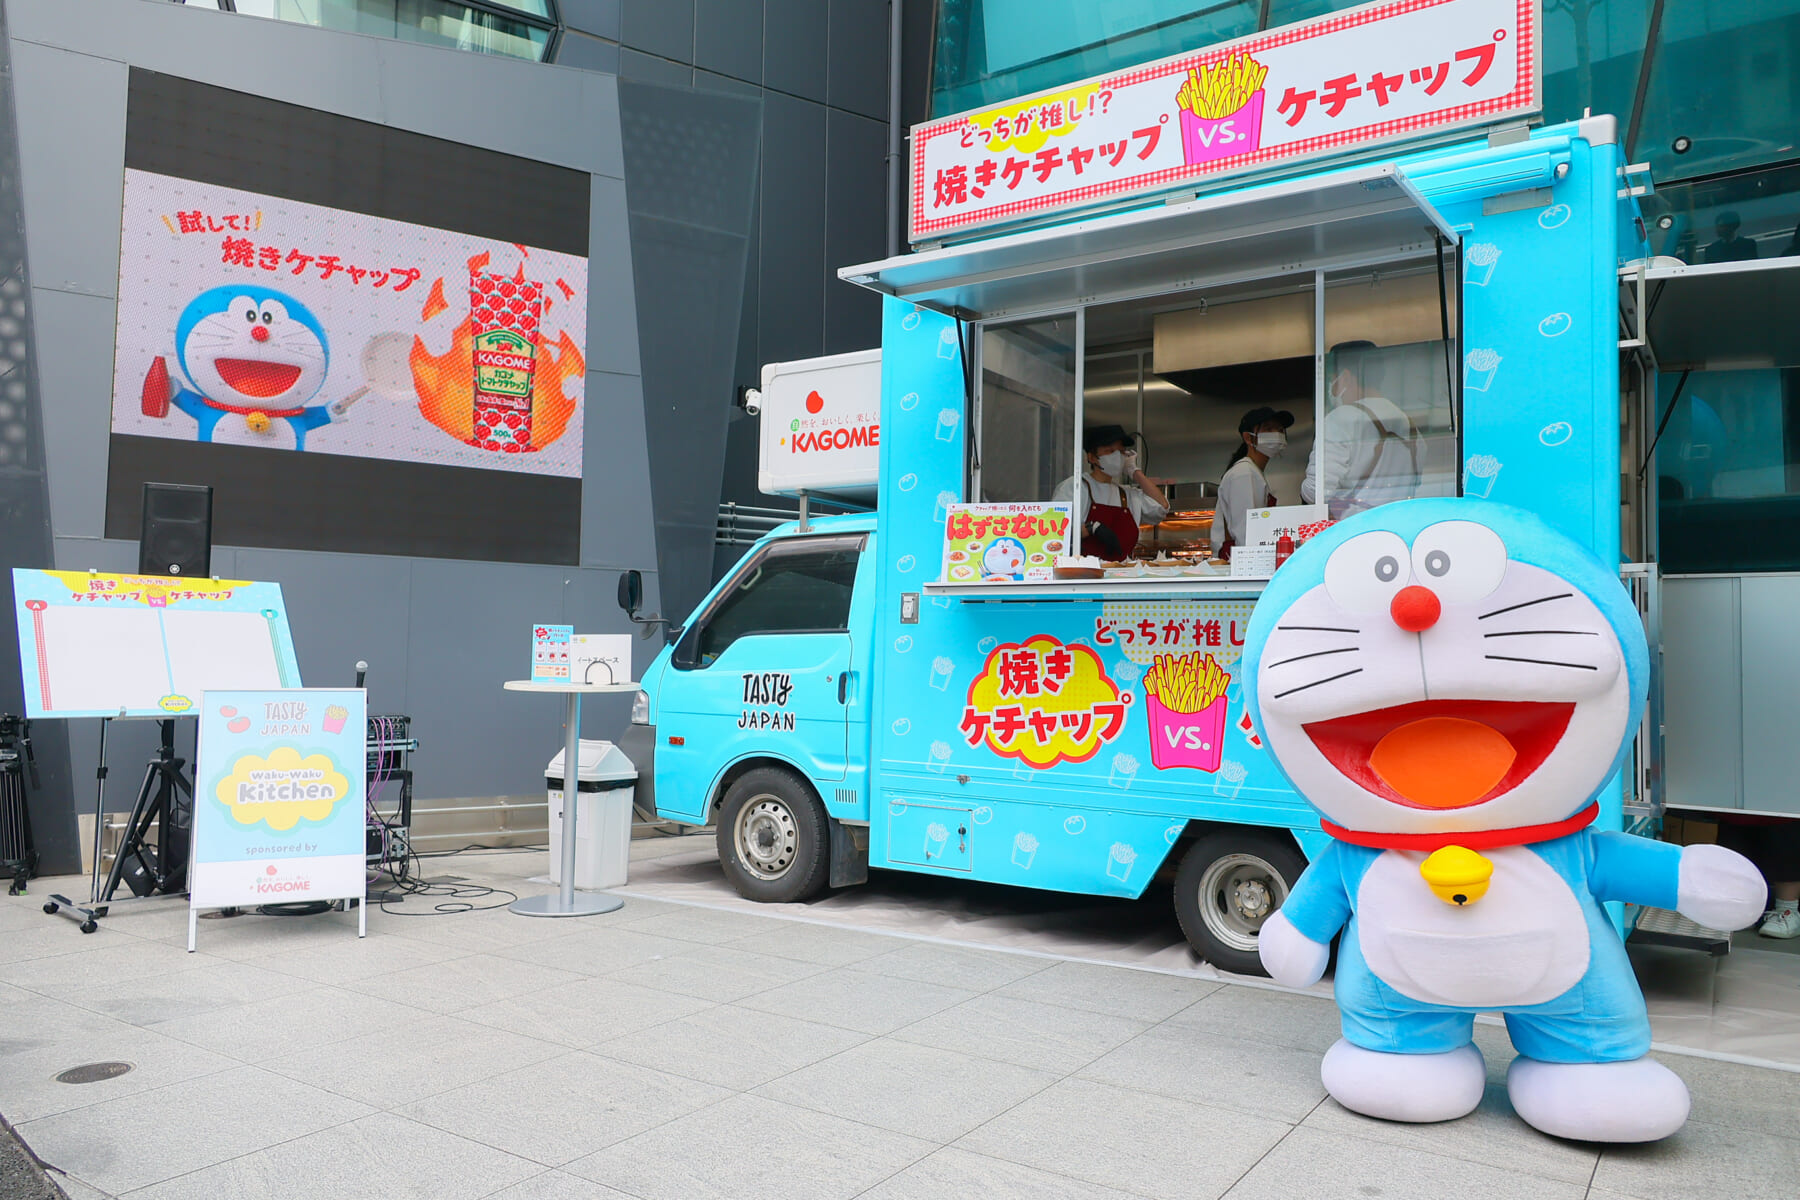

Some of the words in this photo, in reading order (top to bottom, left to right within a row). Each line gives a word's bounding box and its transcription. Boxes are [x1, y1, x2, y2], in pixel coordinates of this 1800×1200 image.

[1277, 28, 1507, 128] ケチャップ
[1198, 120, 1246, 148] VS.
[933, 113, 1169, 209] 焼きケチャップ
[177, 210, 250, 234] 試して!
[221, 235, 421, 292] 焼きケチャップ
[478, 353, 531, 370] KAGOME
[791, 425, 880, 454] KAGOME
[947, 513, 1069, 540] はずさない!
[71, 590, 142, 602] ケチャップ
[89, 579, 117, 590] 焼き
[170, 588, 234, 600] ケチャップ
[33, 602, 40, 610] A
[999, 650, 1072, 696] 焼き
[261, 724, 310, 735] JAPAN
[738, 711, 794, 731] JAPAN
[960, 693, 1132, 746] ケチャップ
[1164, 725, 1211, 751] VS.
[246, 843, 302, 855] sponsored
[305, 843, 318, 853] by
[257, 880, 311, 893] KAGOME
